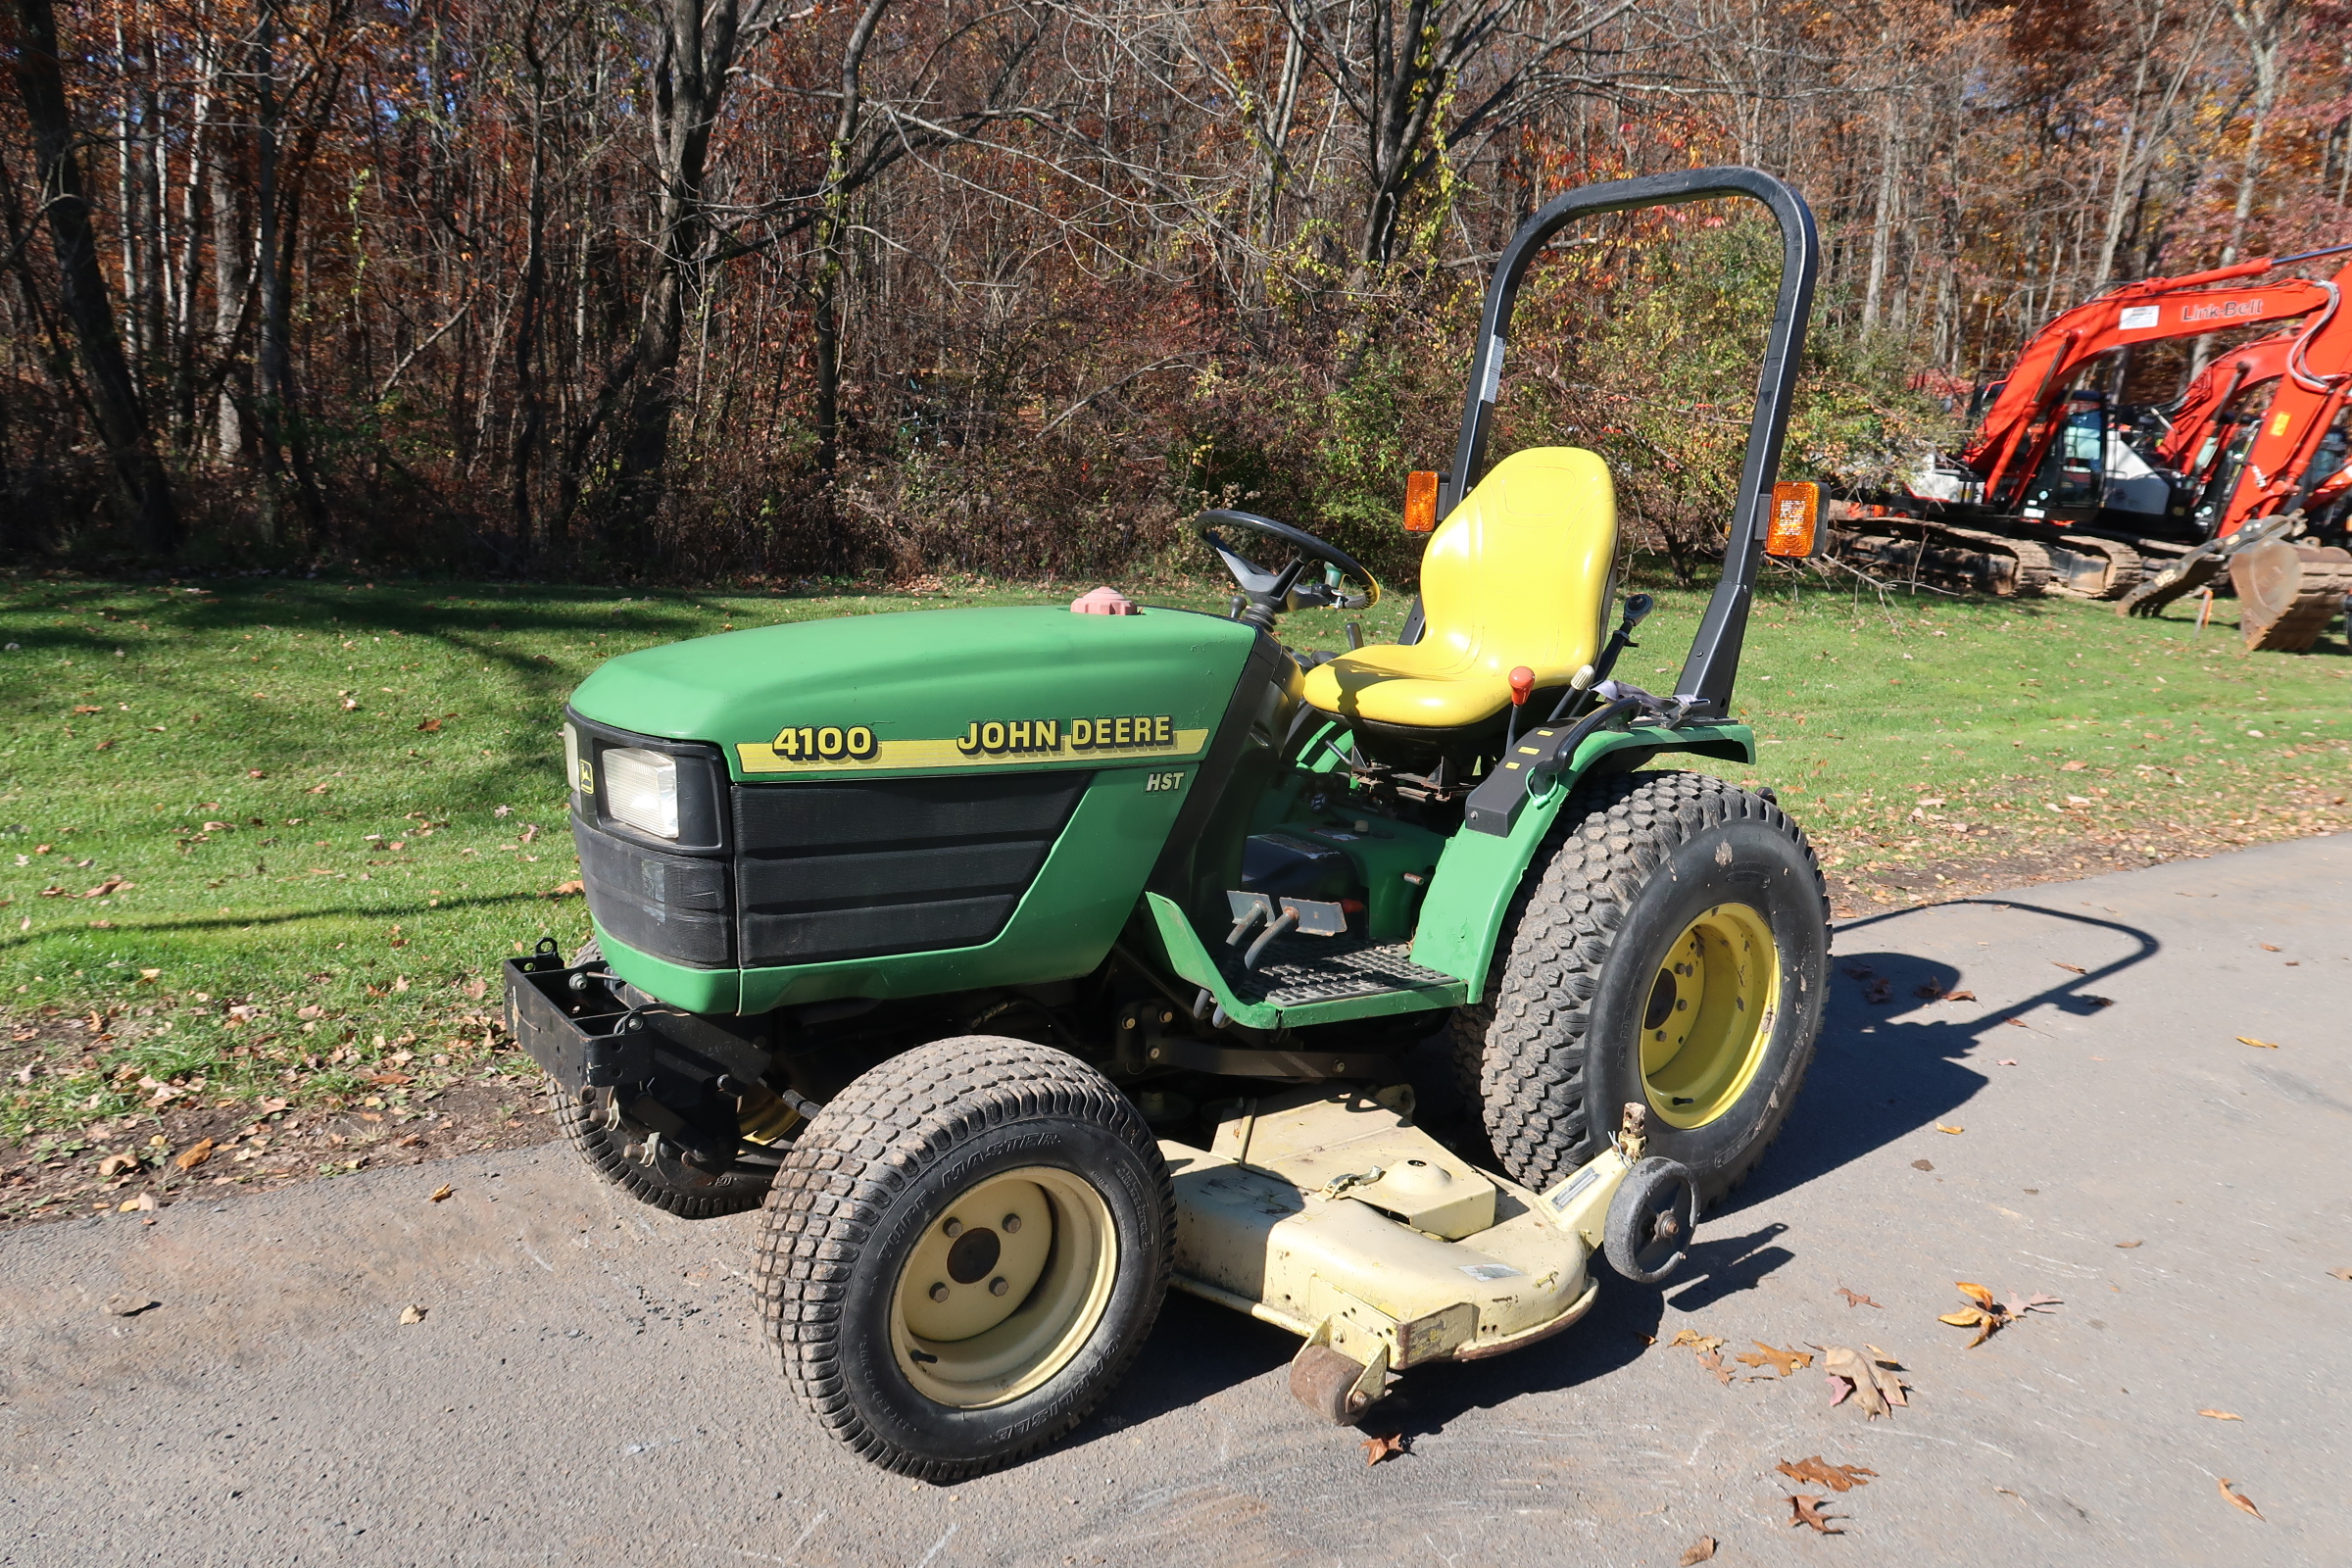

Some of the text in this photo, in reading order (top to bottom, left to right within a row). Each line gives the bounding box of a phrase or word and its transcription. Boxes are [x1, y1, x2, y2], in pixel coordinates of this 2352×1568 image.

[2181, 299, 2263, 321] Link-Belt
[772, 725, 878, 760] 4100
[956, 715, 1174, 753] JOHN DEERE
[1146, 773, 1184, 792] HST
[877, 1132, 1057, 1260] TURF MASTER
[995, 1339, 1118, 1444] CARLISLE
